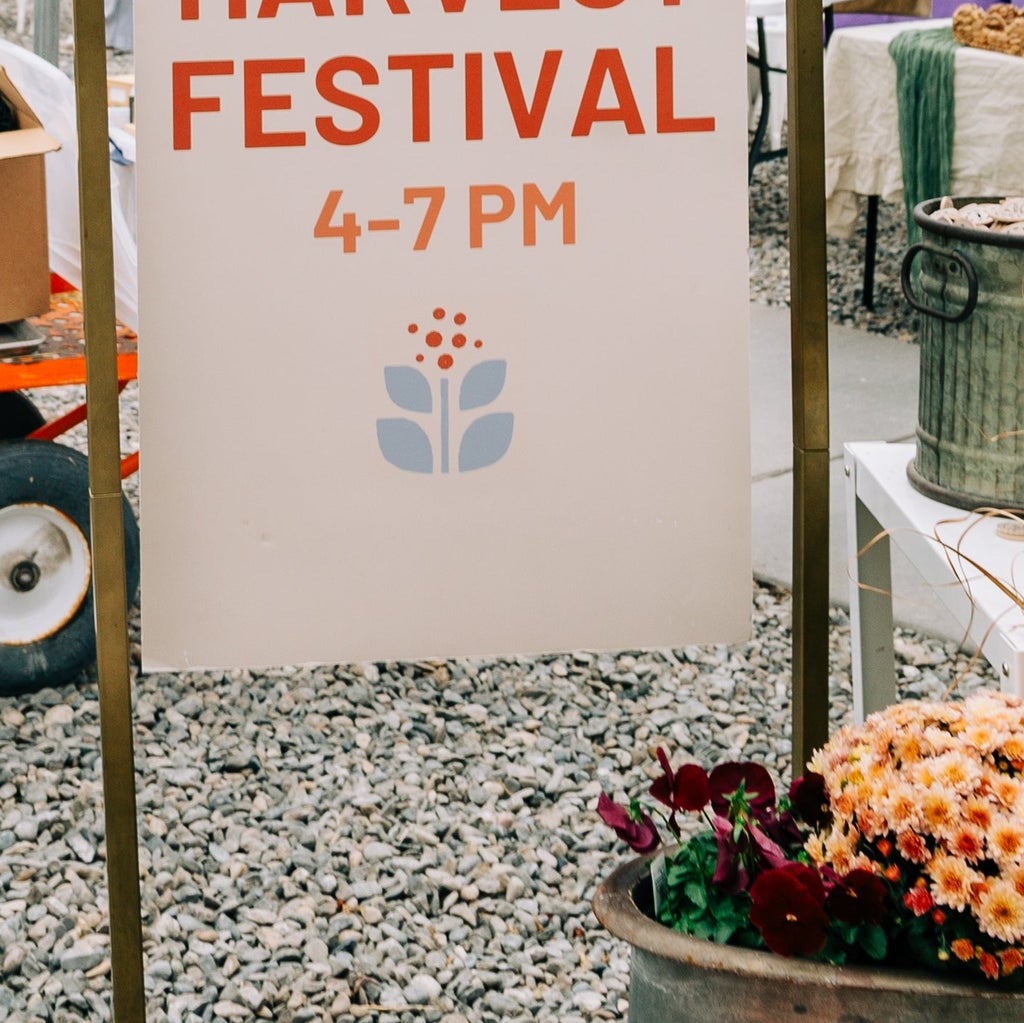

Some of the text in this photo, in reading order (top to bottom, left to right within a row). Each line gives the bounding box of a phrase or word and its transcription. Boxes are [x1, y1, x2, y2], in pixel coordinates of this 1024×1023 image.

[172, 46, 715, 151] FESTIVAL
[314, 182, 575, 253] 4-7 PM
